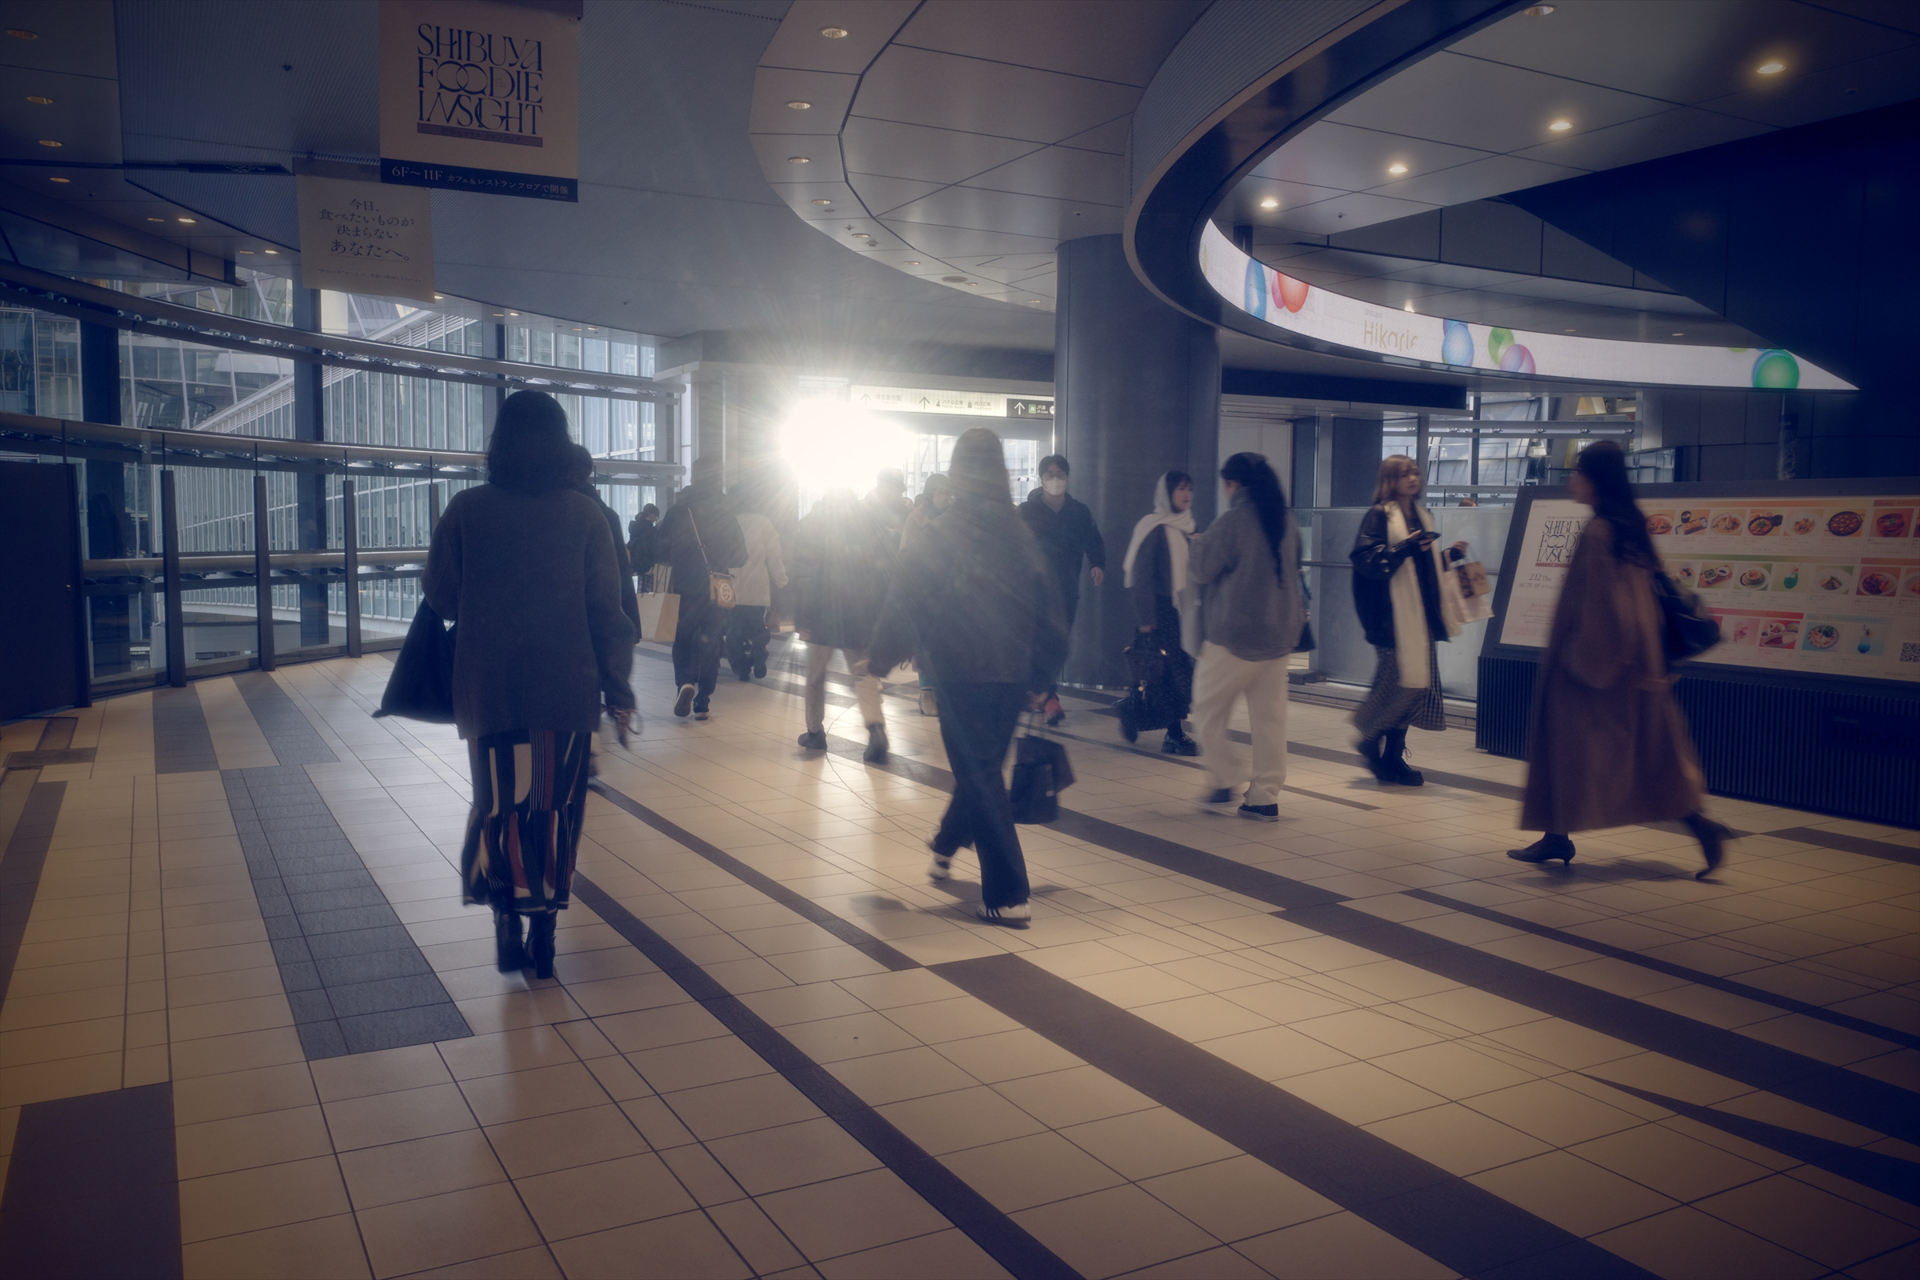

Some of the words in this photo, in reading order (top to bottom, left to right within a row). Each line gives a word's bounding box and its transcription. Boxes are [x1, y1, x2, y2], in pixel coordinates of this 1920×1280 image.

[417, 23, 543, 72] SHIBUYA
[417, 56, 543, 104] FOODIE
[418, 89, 543, 135] INSIGHT
[319, 208, 415, 227] 食べたいものが
[336, 223, 399, 240] 決まらない
[1542, 520, 1585, 535] SHIBUY
[1539, 534, 1581, 549] FOODI
